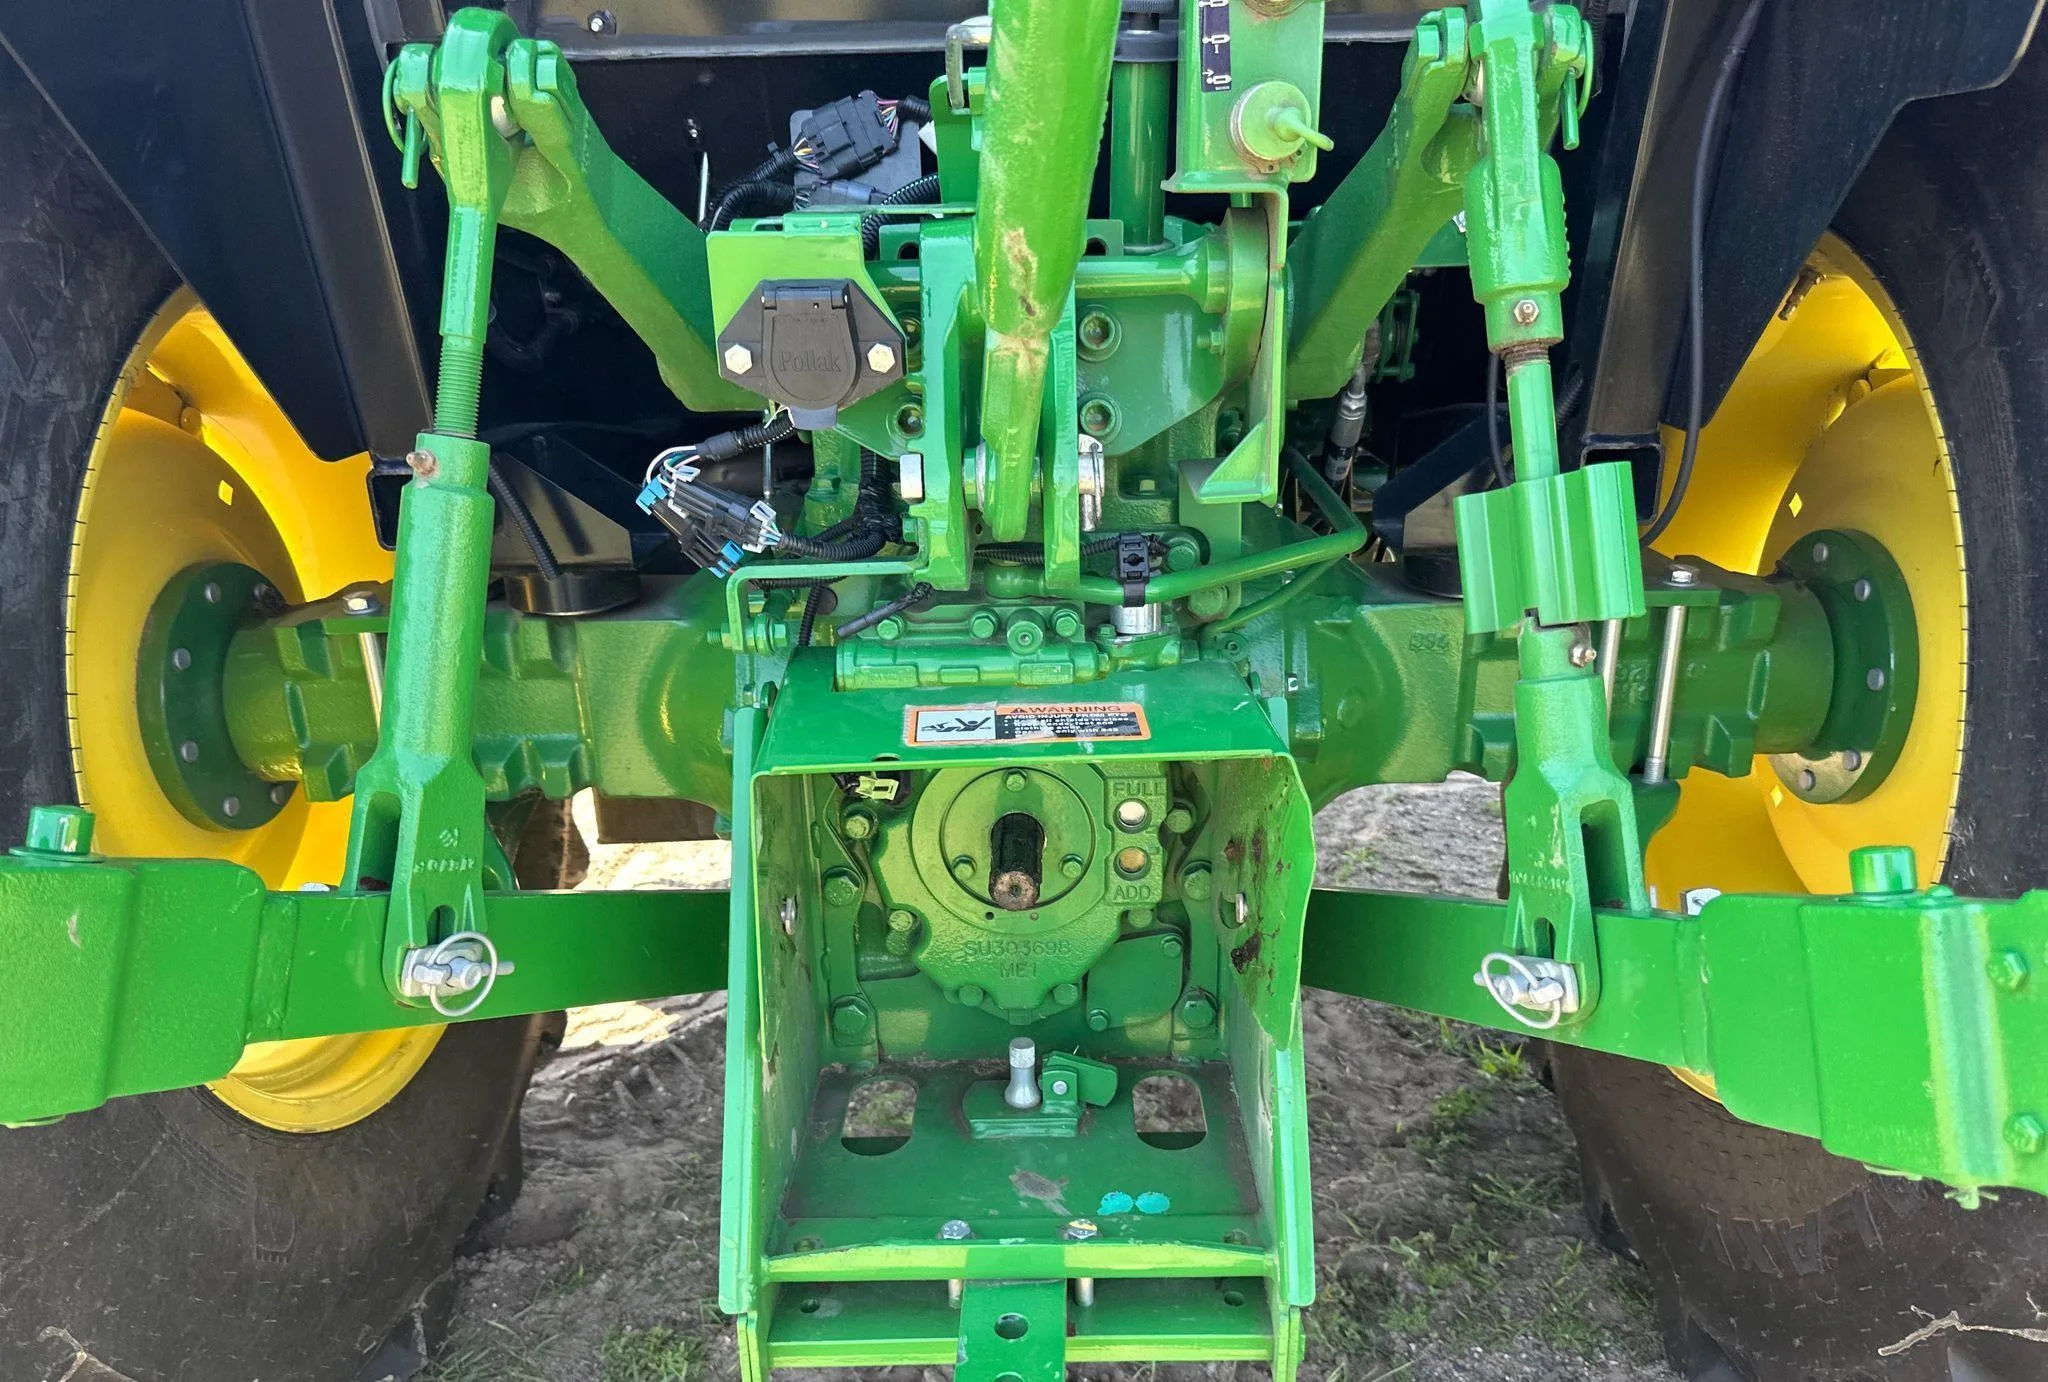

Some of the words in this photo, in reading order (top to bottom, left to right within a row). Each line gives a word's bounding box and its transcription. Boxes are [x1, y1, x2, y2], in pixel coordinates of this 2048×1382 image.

[779, 350, 841, 372] Pollak
[1029, 705, 1120, 713] WARNING
[1113, 782, 1165, 796] FULL
[1113, 885, 1151, 900] ADD
